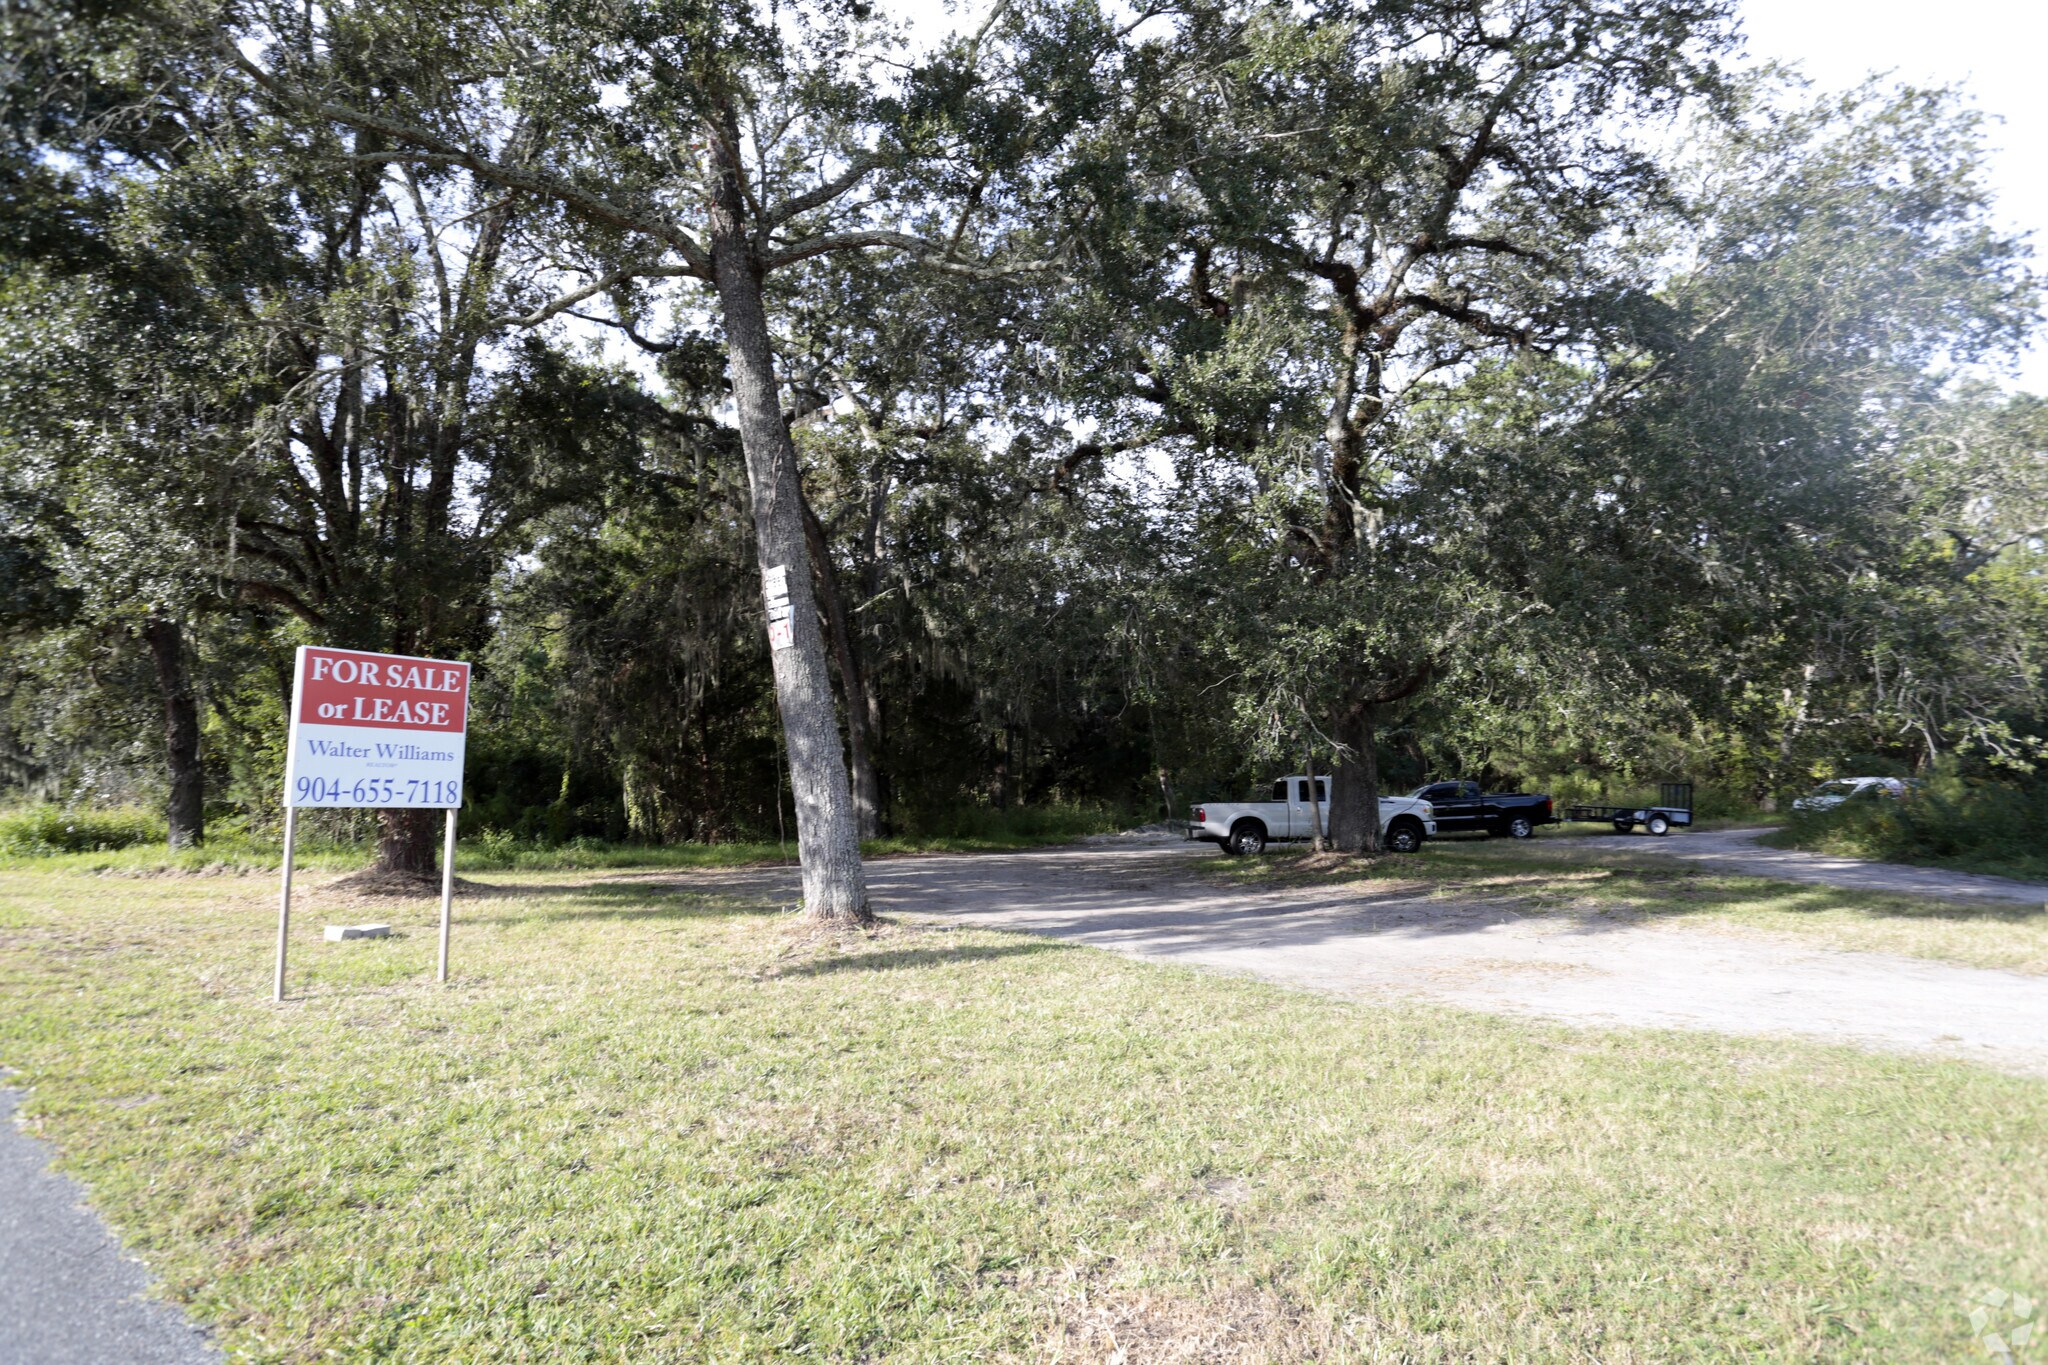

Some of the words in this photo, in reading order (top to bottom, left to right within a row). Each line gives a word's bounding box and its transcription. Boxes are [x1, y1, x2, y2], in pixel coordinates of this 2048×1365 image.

[311, 656, 381, 686] FOR
[386, 664, 461, 692] SALE
[317, 702, 349, 719] or
[352, 697, 450, 726] LEASE
[308, 740, 371, 759] Walter
[375, 743, 455, 762] Williams
[296, 776, 458, 804] 904-655-7118
